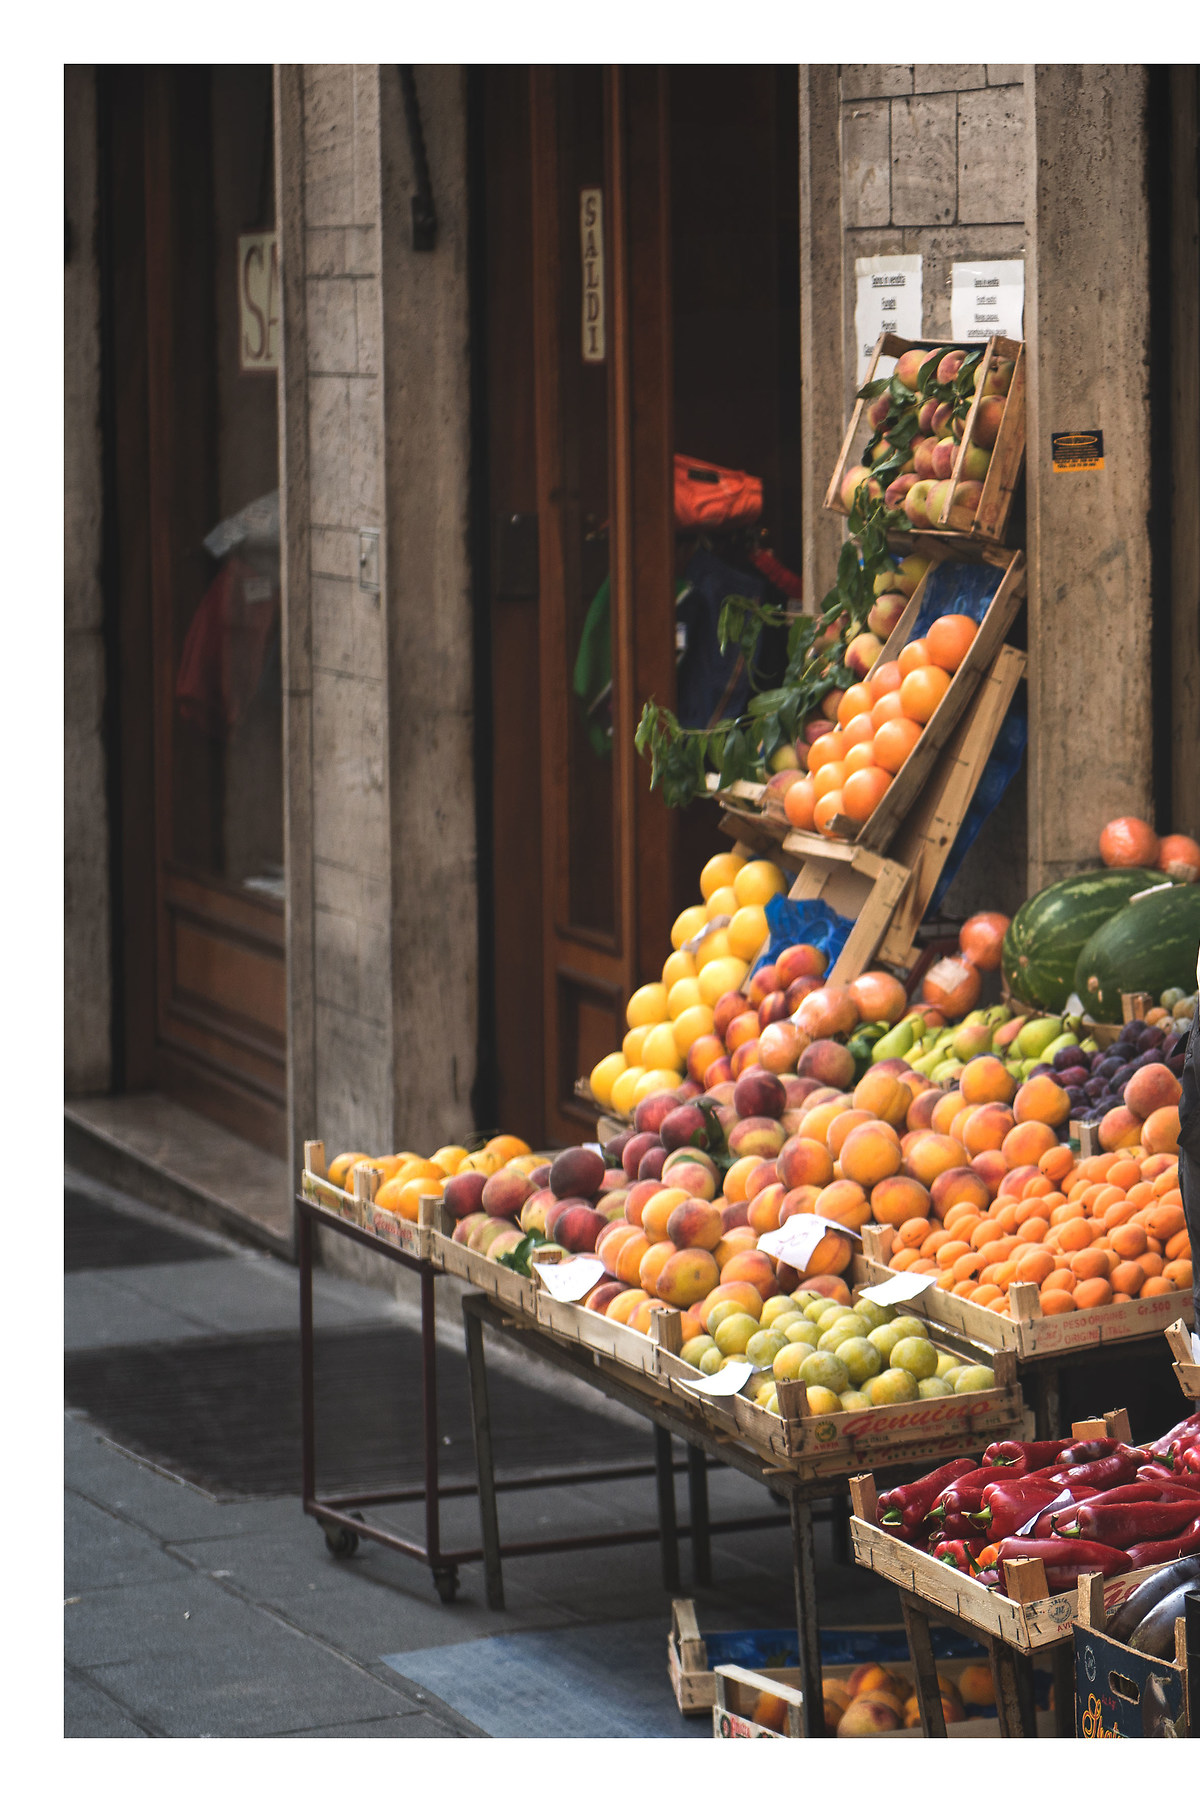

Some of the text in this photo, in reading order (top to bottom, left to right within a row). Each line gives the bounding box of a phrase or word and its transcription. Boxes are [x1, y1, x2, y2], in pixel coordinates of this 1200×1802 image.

[584, 195, 600, 354] SALDI
[1063, 1319, 1087, 1330] PESO
[842, 1399, 994, 1439] Genuino
